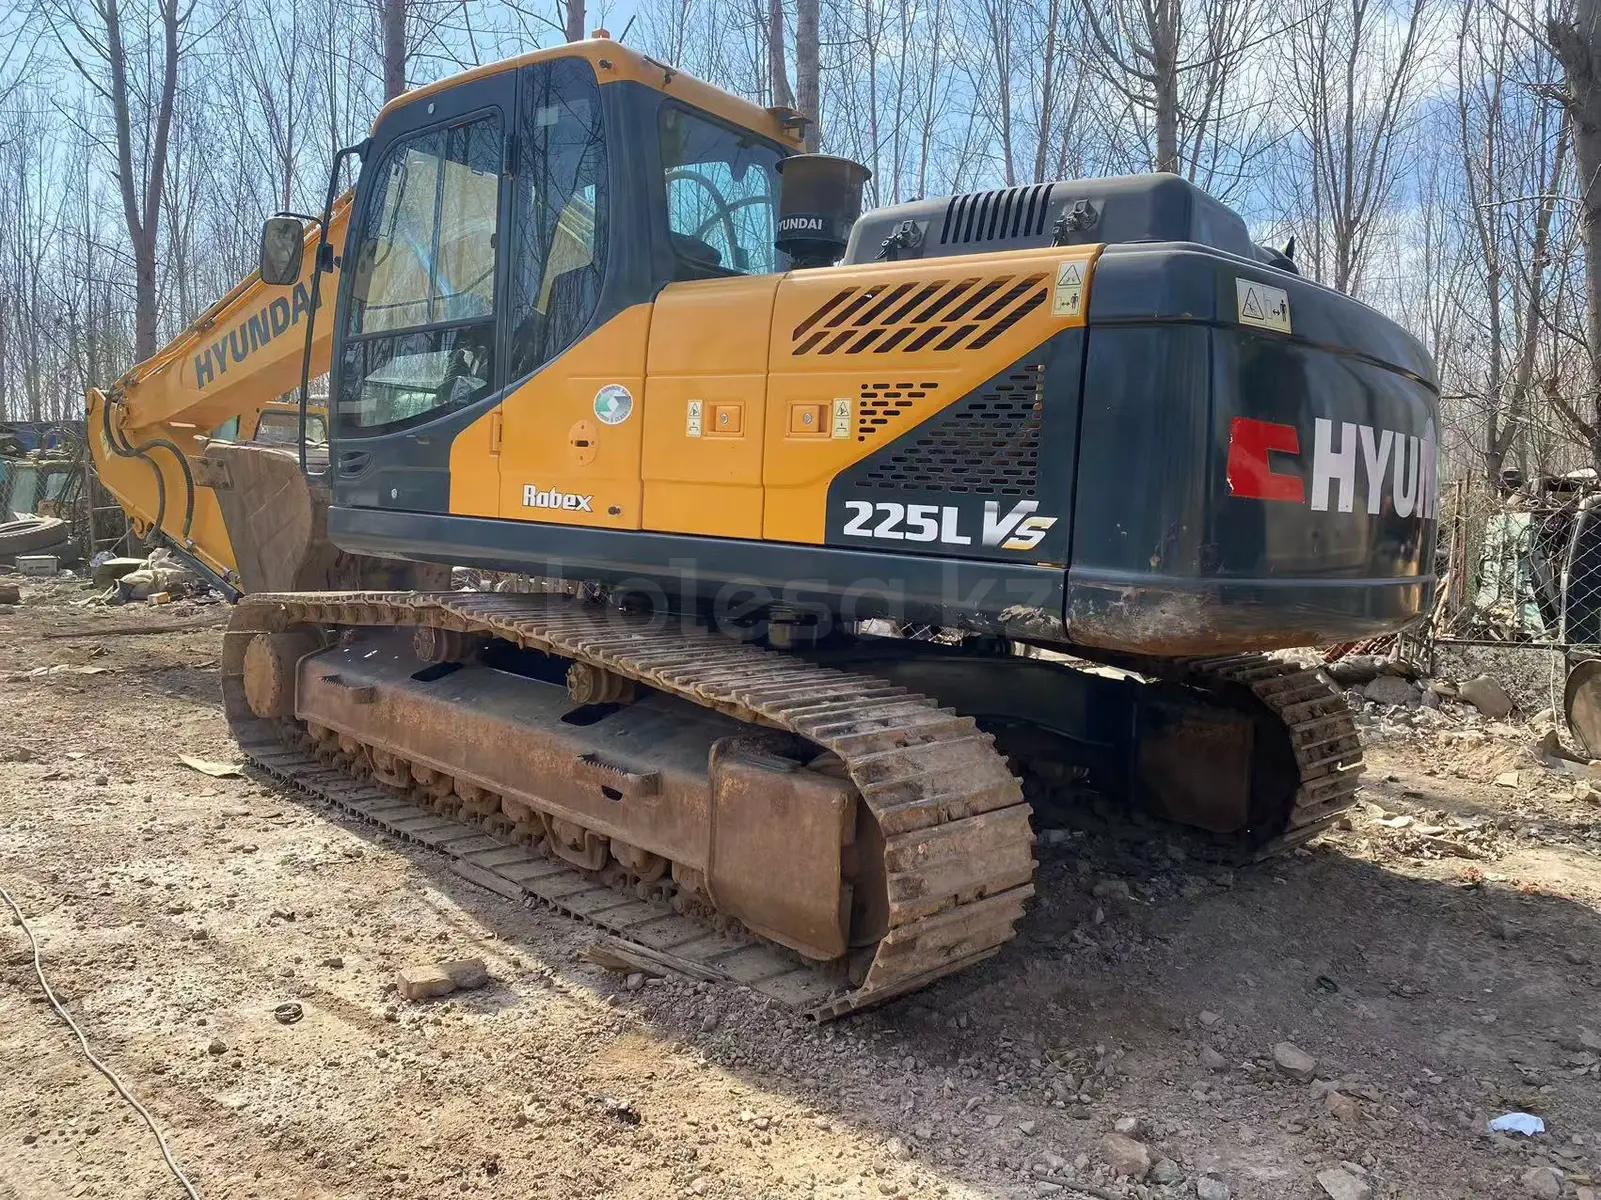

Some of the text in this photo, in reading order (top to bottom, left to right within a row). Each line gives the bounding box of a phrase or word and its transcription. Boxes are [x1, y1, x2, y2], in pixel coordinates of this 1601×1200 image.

[777, 217, 823, 232] YUNDAI
[522, 484, 594, 513] Robex
[843, 500, 972, 545] 225L
